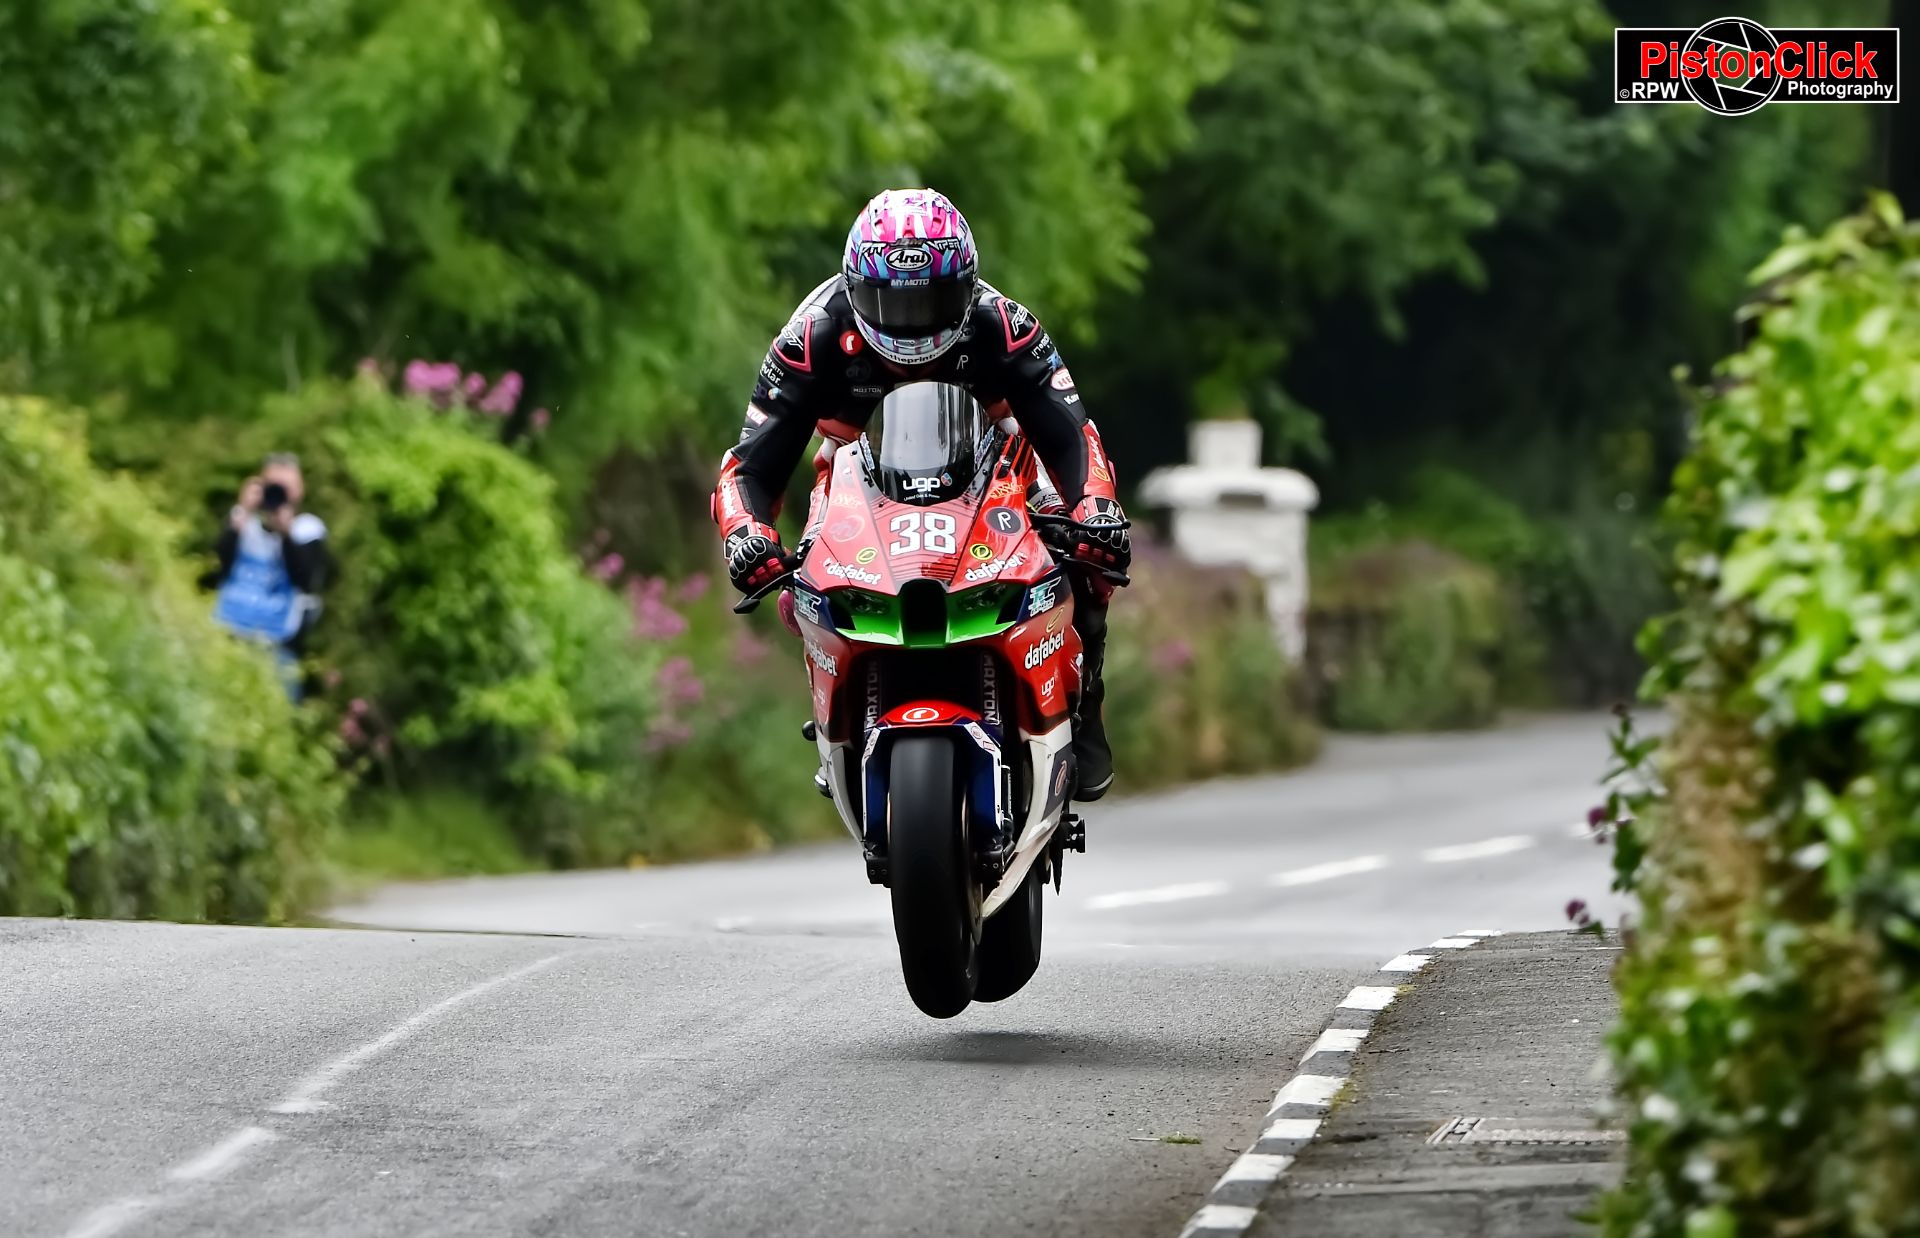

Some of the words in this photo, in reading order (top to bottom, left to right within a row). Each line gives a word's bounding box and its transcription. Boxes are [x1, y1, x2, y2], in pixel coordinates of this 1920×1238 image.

[889, 250, 926, 264] Arai
[903, 478, 940, 492] ugp
[890, 512, 955, 556] 38
[826, 561, 882, 585] dafabet
[965, 557, 1024, 581] dafabet
[1025, 627, 1065, 669] dafabet
[984, 655, 998, 724] MAXTON
